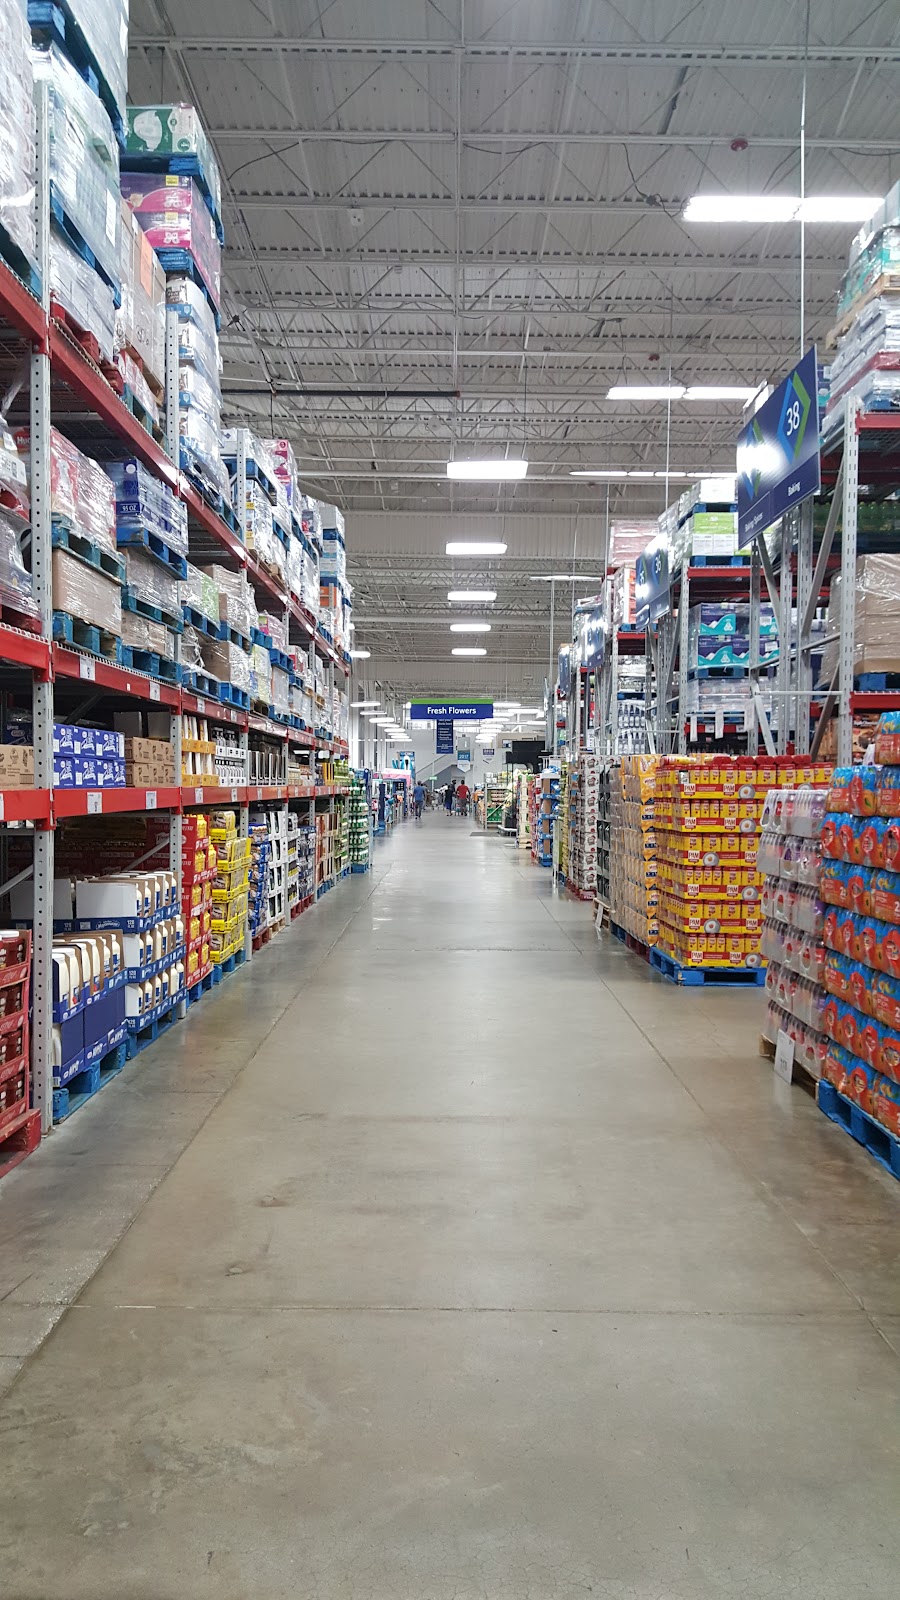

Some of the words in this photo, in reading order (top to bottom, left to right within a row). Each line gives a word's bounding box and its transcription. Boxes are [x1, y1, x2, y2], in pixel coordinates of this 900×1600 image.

[786, 400, 800, 437] 38
[787, 481, 801, 497] Baking
[427, 706, 447, 715] Fresh
[448, 706, 477, 715] Flowers
[684, 784, 696, 792] PAM
[724, 784, 735, 792] PAM
[688, 851, 699, 859] PAM
[745, 851, 757, 859] PAM
[730, 952, 741, 960] PAM
